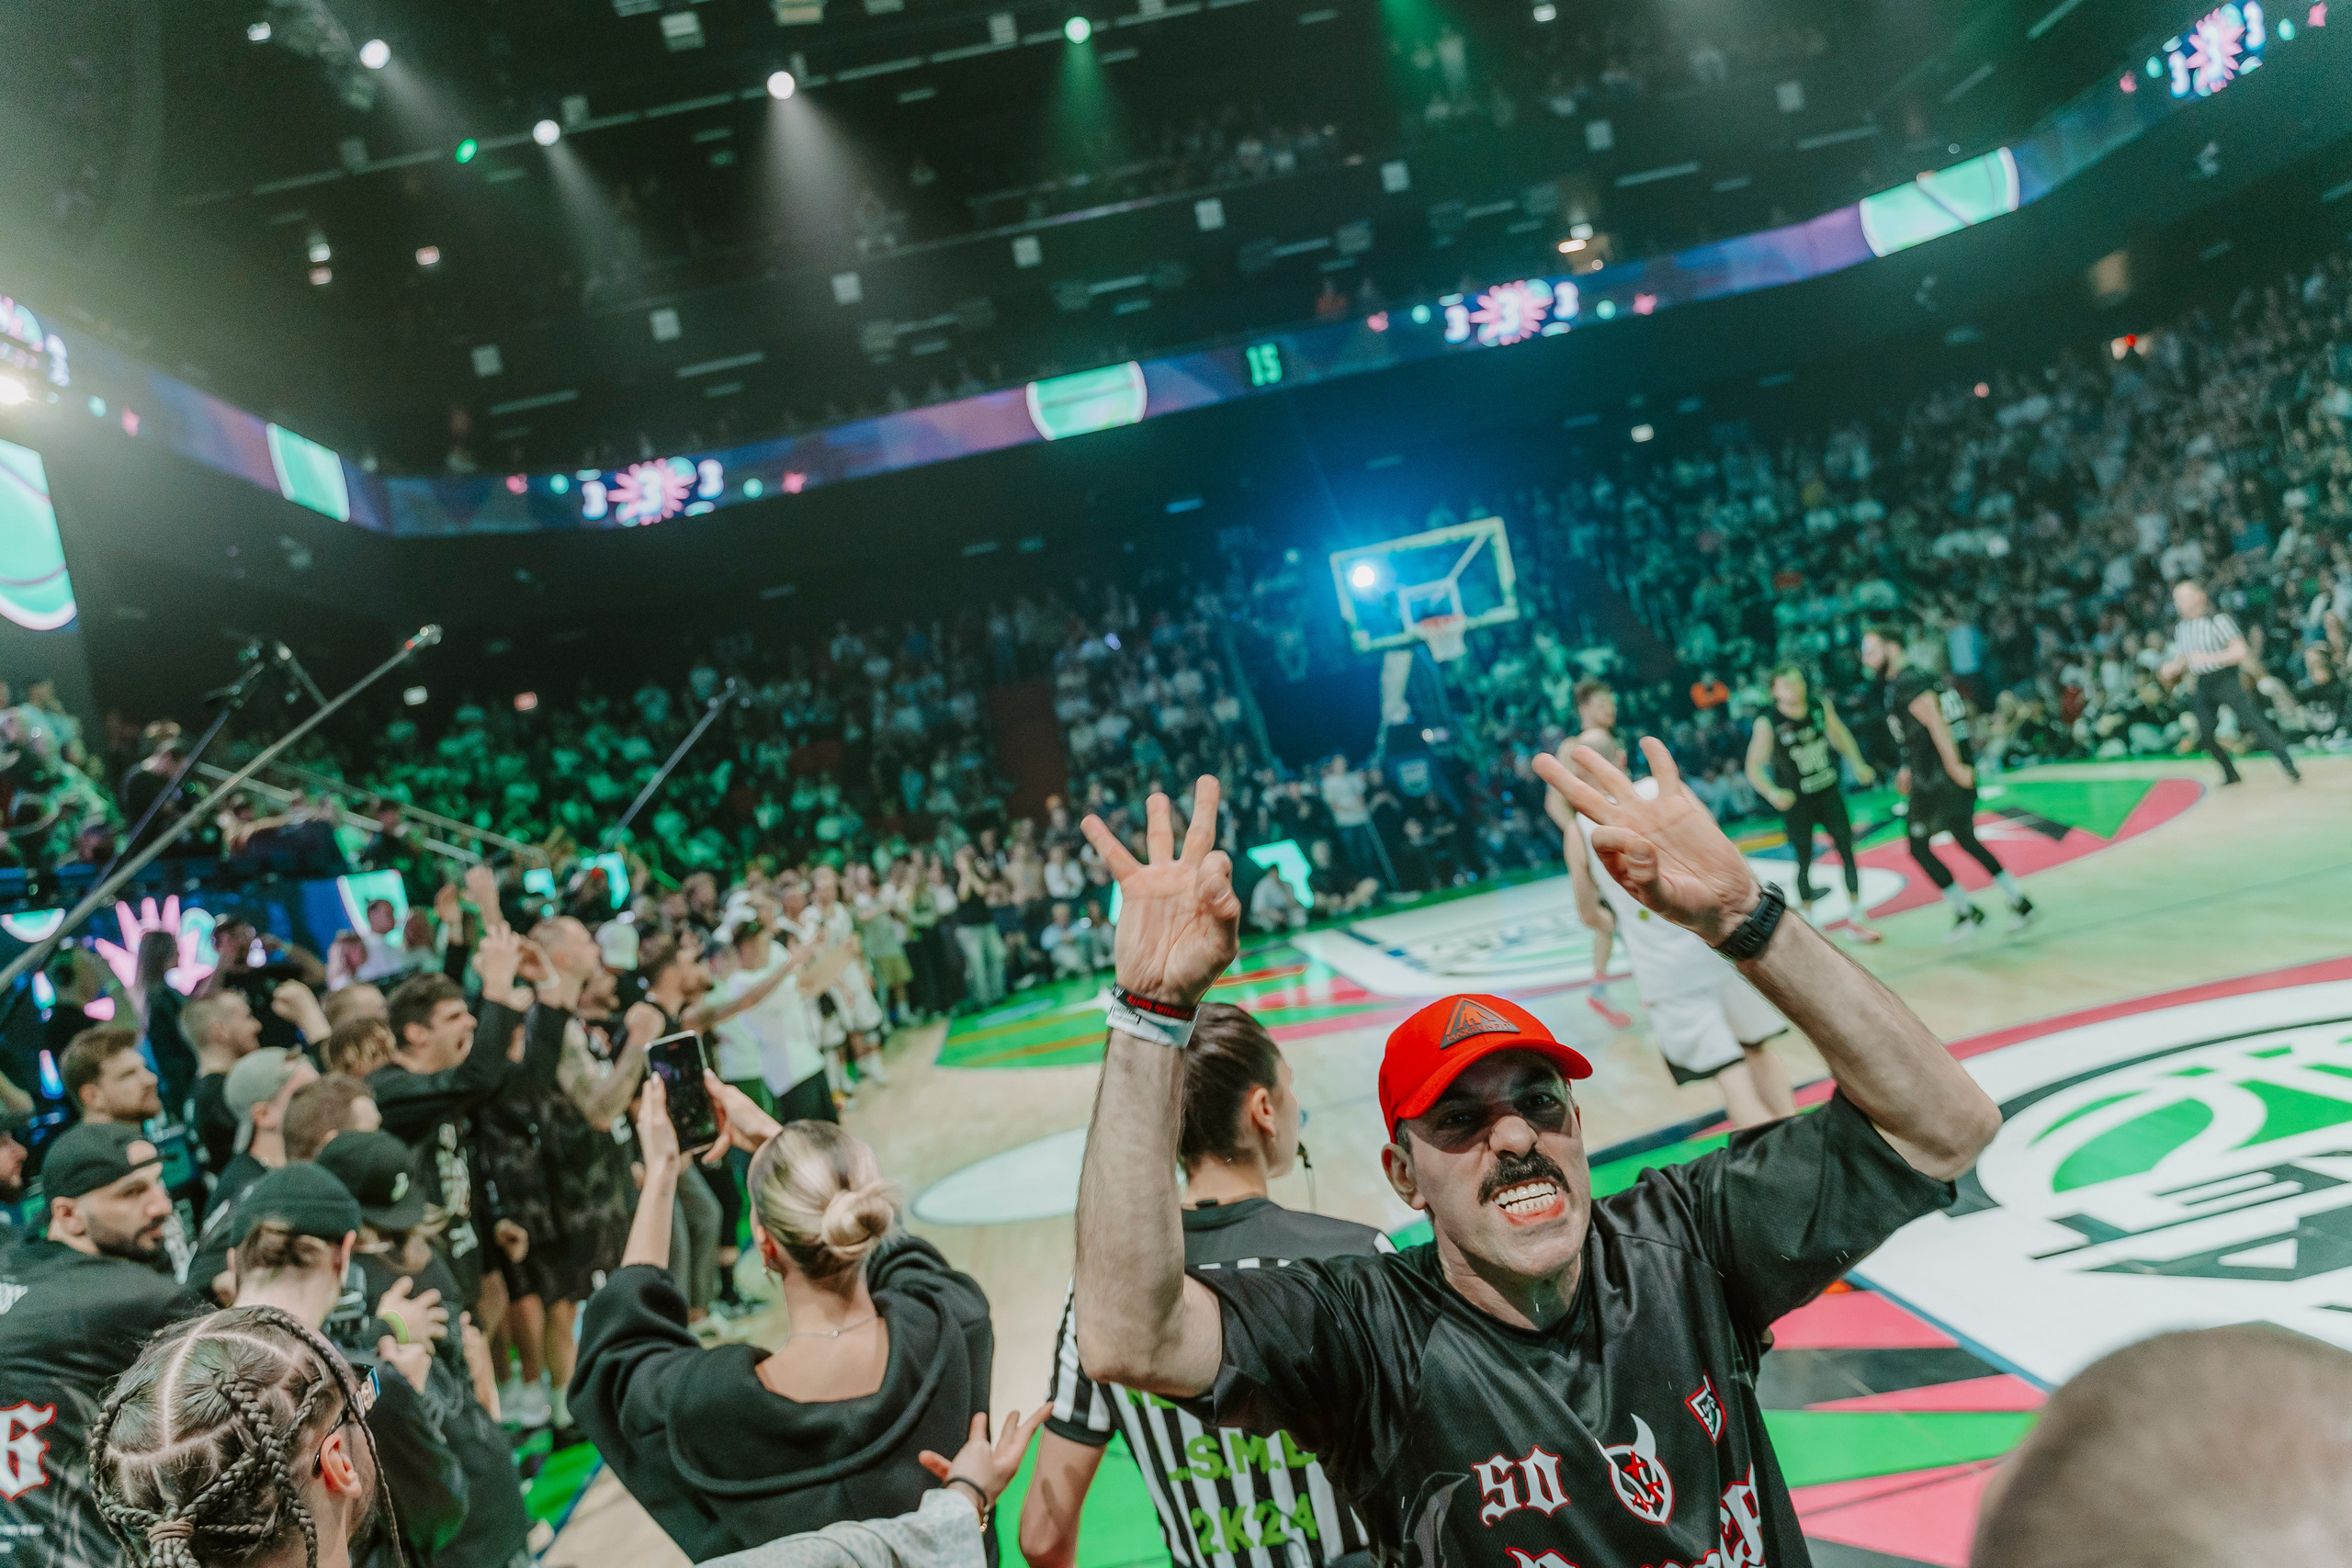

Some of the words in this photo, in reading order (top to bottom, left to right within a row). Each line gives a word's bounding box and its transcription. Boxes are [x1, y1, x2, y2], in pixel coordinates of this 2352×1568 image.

[1246, 343, 1283, 386] 15
[1447, 1023, 1510, 1043] MAXFUNFIT
[1191, 1493, 1317, 1554] 2K24
